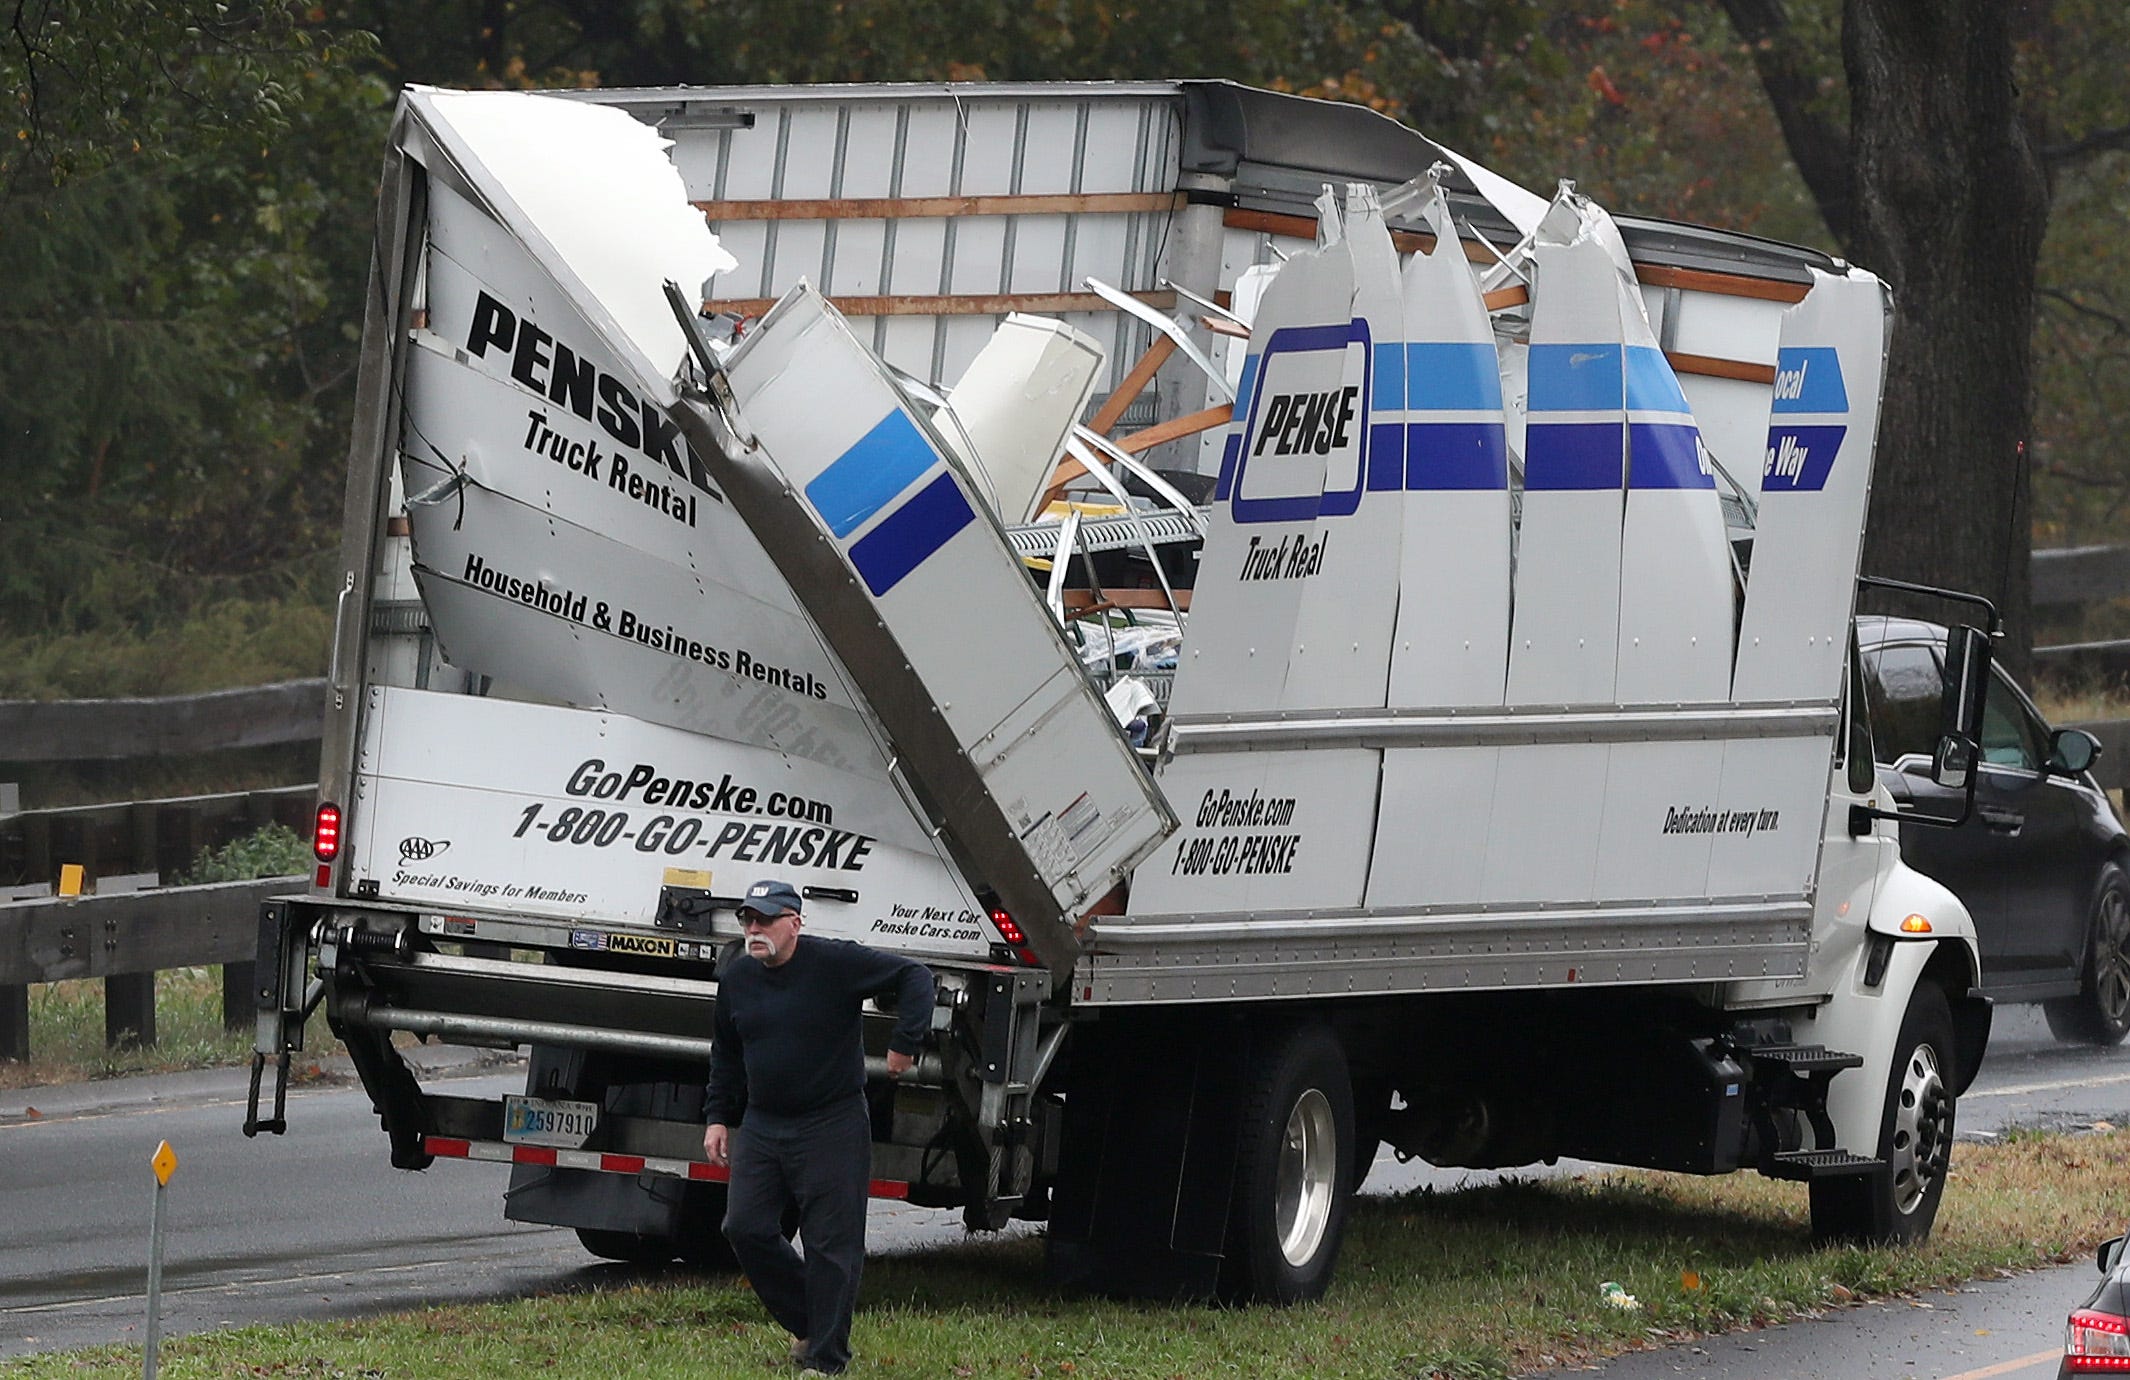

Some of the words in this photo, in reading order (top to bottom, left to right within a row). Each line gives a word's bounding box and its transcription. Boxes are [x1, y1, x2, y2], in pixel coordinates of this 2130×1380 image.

[1775, 359, 1808, 399] ocal
[1253, 386, 1358, 456] PENSE
[524, 410, 604, 481] Truck
[609, 462, 697, 528] Rental
[1774, 436, 1808, 486] Way
[1240, 535, 1288, 580] Truck
[464, 553, 587, 622] Household
[594, 602, 612, 630] &
[618, 610, 730, 669] Business
[735, 650, 827, 700] Rentals
[565, 758, 833, 824] GoPenske.com
[1196, 788, 1296, 827] GoPenske.com
[512, 803, 876, 871] 1-800-GO-PENSKE
[1663, 806, 1717, 834] Dedication
[1717, 809, 1731, 832] at
[1729, 811, 1757, 838] every
[1757, 808, 1779, 831] turn.
[400, 837, 432, 859] AAA
[1172, 835, 1300, 875] 1-800-GO-PENSKE
[392, 870, 447, 887] Special
[446, 876, 499, 896] Savings
[502, 883, 523, 898] for
[525, 886, 588, 904] Members
[891, 904, 919, 919] Your
[921, 907, 954, 922] Next
[958, 910, 982, 924] Car
[611, 936, 671, 954] MAXON
[526, 1110, 593, 1136] 2597910
